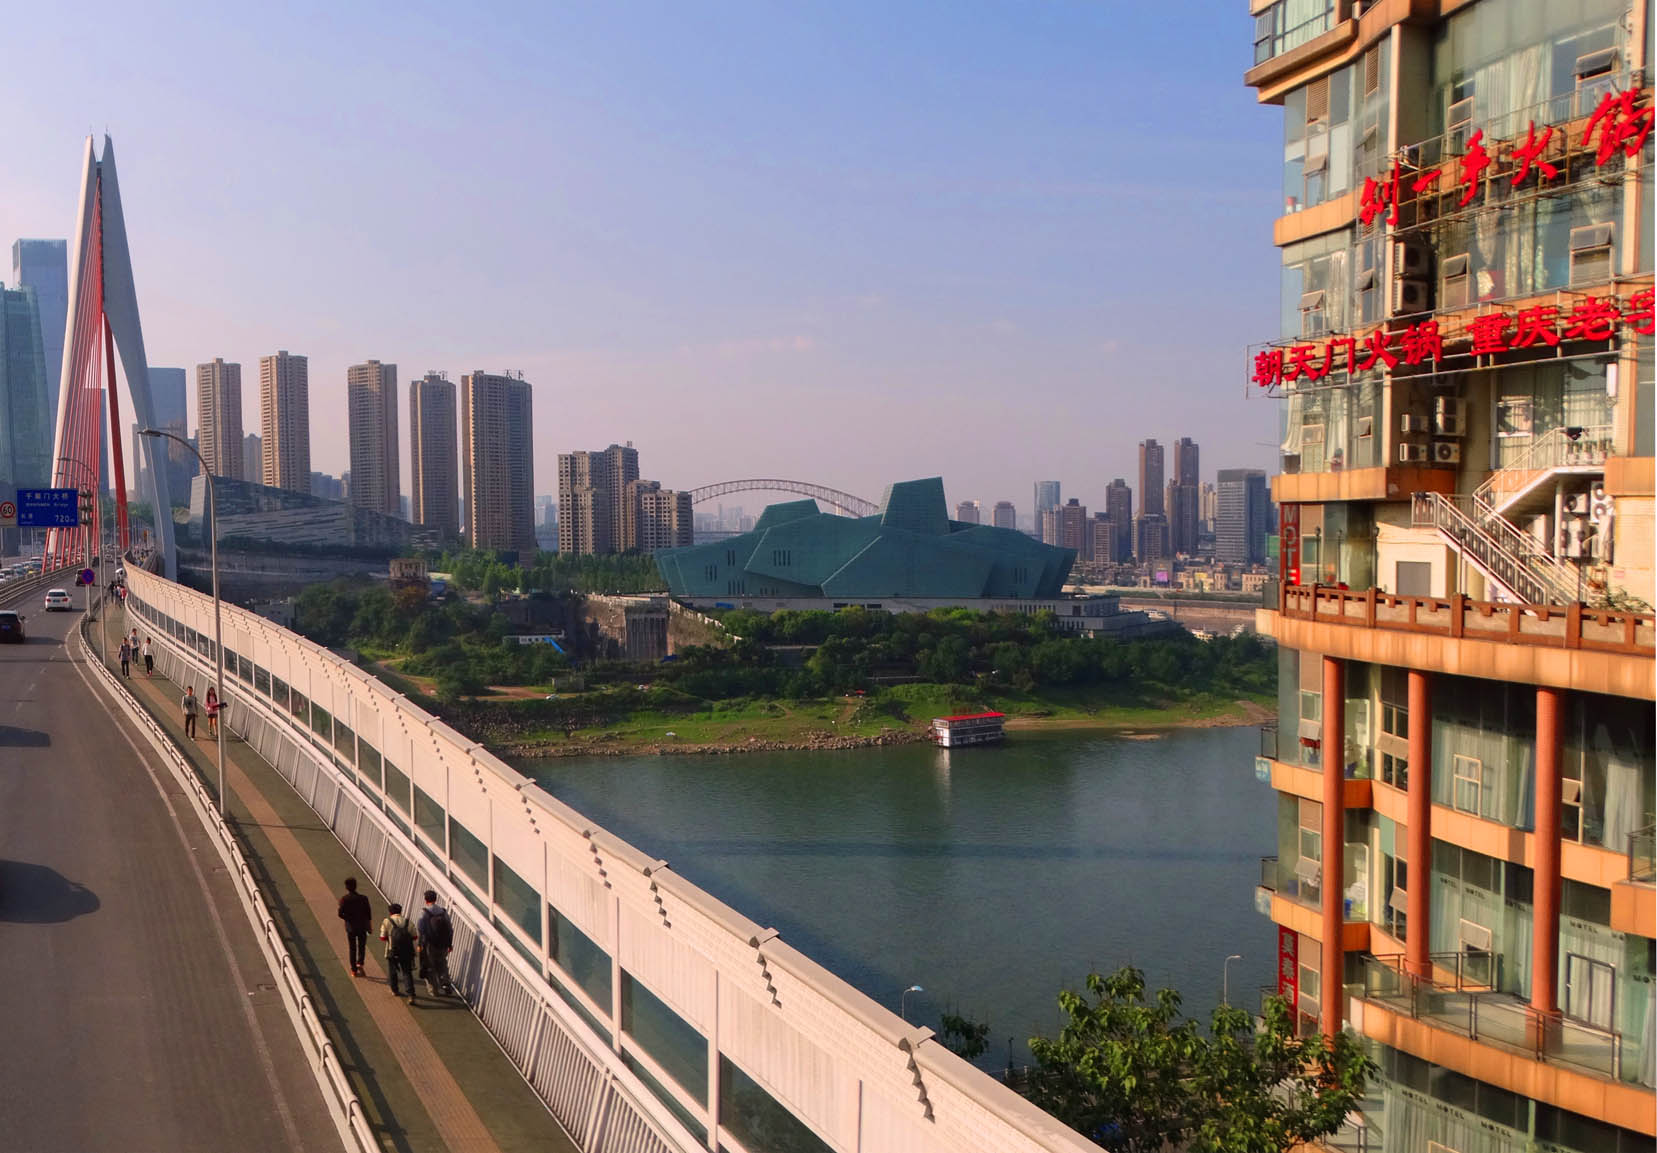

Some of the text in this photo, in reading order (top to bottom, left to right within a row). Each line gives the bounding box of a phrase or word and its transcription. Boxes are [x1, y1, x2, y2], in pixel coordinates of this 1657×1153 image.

[1252, 320, 1444, 387] 朝天门火锅
[3, 506, 12, 514] 60
[1436, 1103, 1465, 1120] MOTEL
[1480, 1120, 1512, 1138] MOTEL
